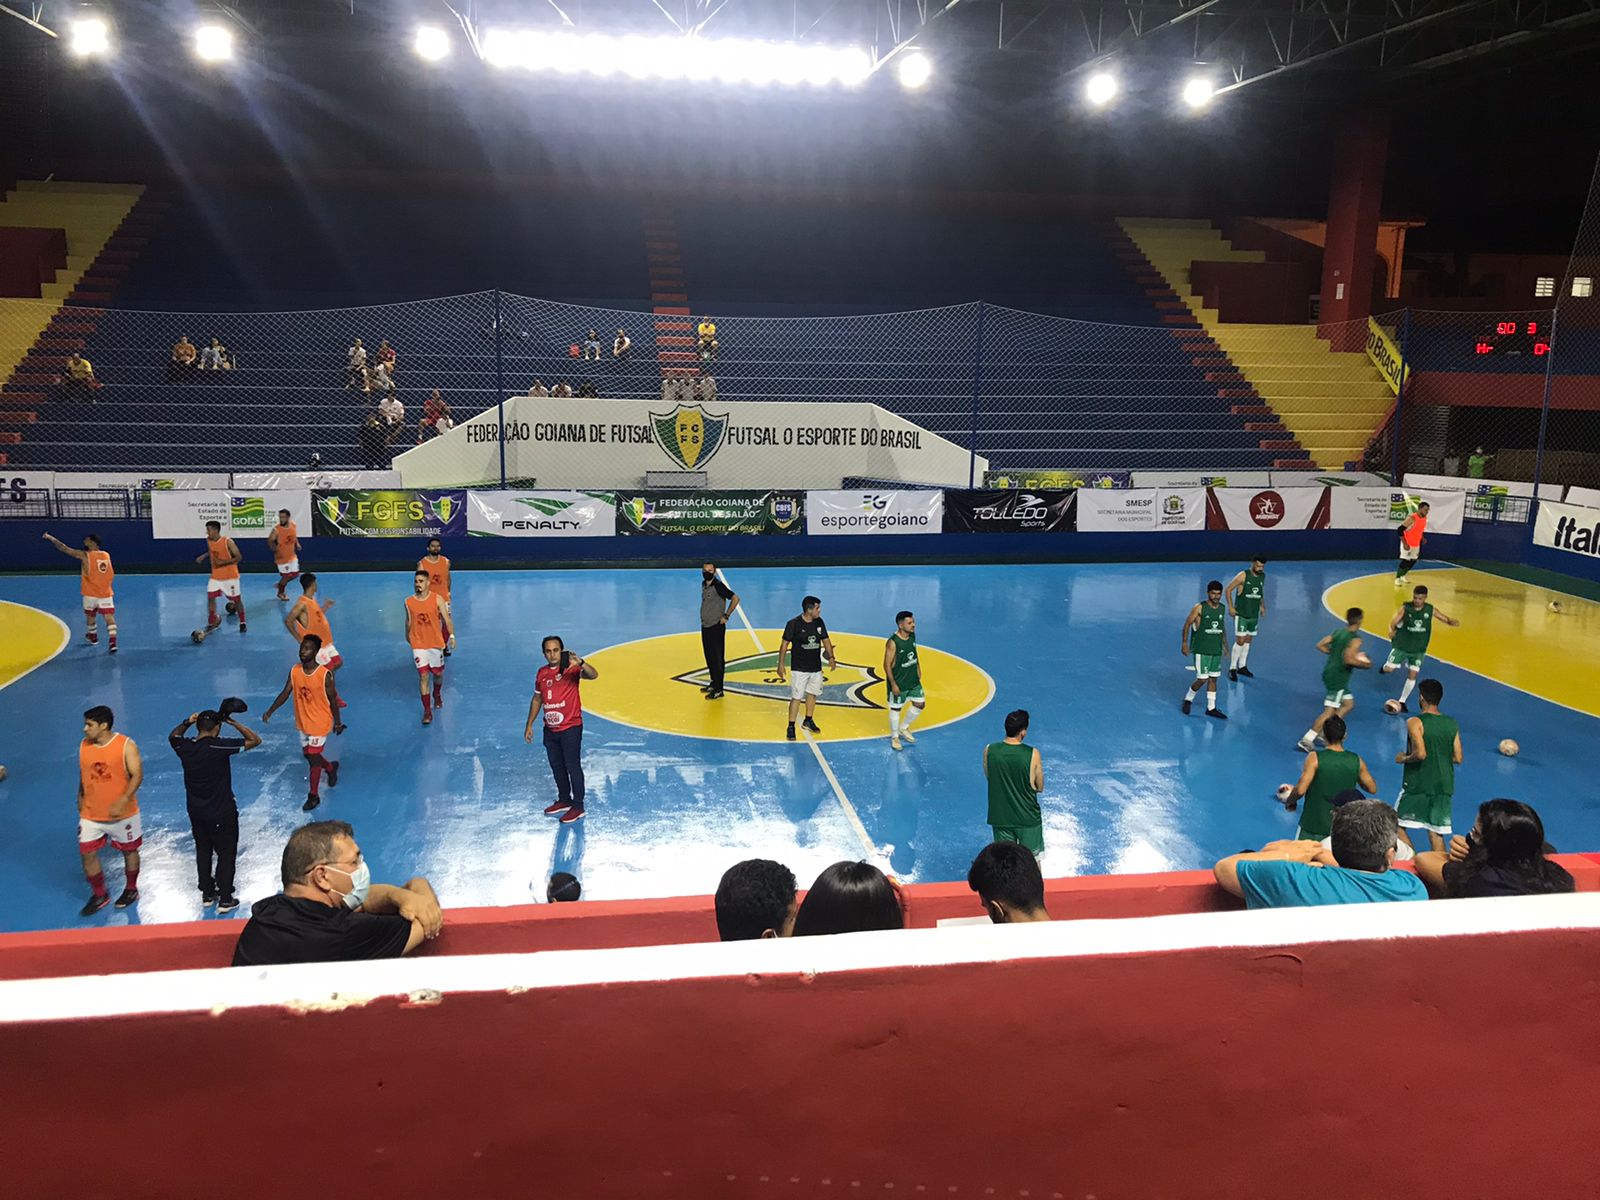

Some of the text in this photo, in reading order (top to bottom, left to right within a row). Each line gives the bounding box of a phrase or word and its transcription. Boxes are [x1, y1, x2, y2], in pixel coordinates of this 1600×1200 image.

[535, 423, 587, 443] GOIANA
[590, 424, 606, 443] DE
[611, 424, 654, 443] FUTSAL
[727, 426, 922, 450] FUTSAL O ESPORTE DO BRASIL
[0, 477, 27, 503] S
[357, 501, 424, 521] FGFS
[660, 498, 765, 508] FEDERAÇÃO GOIANA DE
[724, 509, 756, 518] SALÃO
[821, 513, 928, 529] esportegoiano
[972, 507, 1048, 519] TOLLEDO
[502, 521, 580, 530] PENALTY
